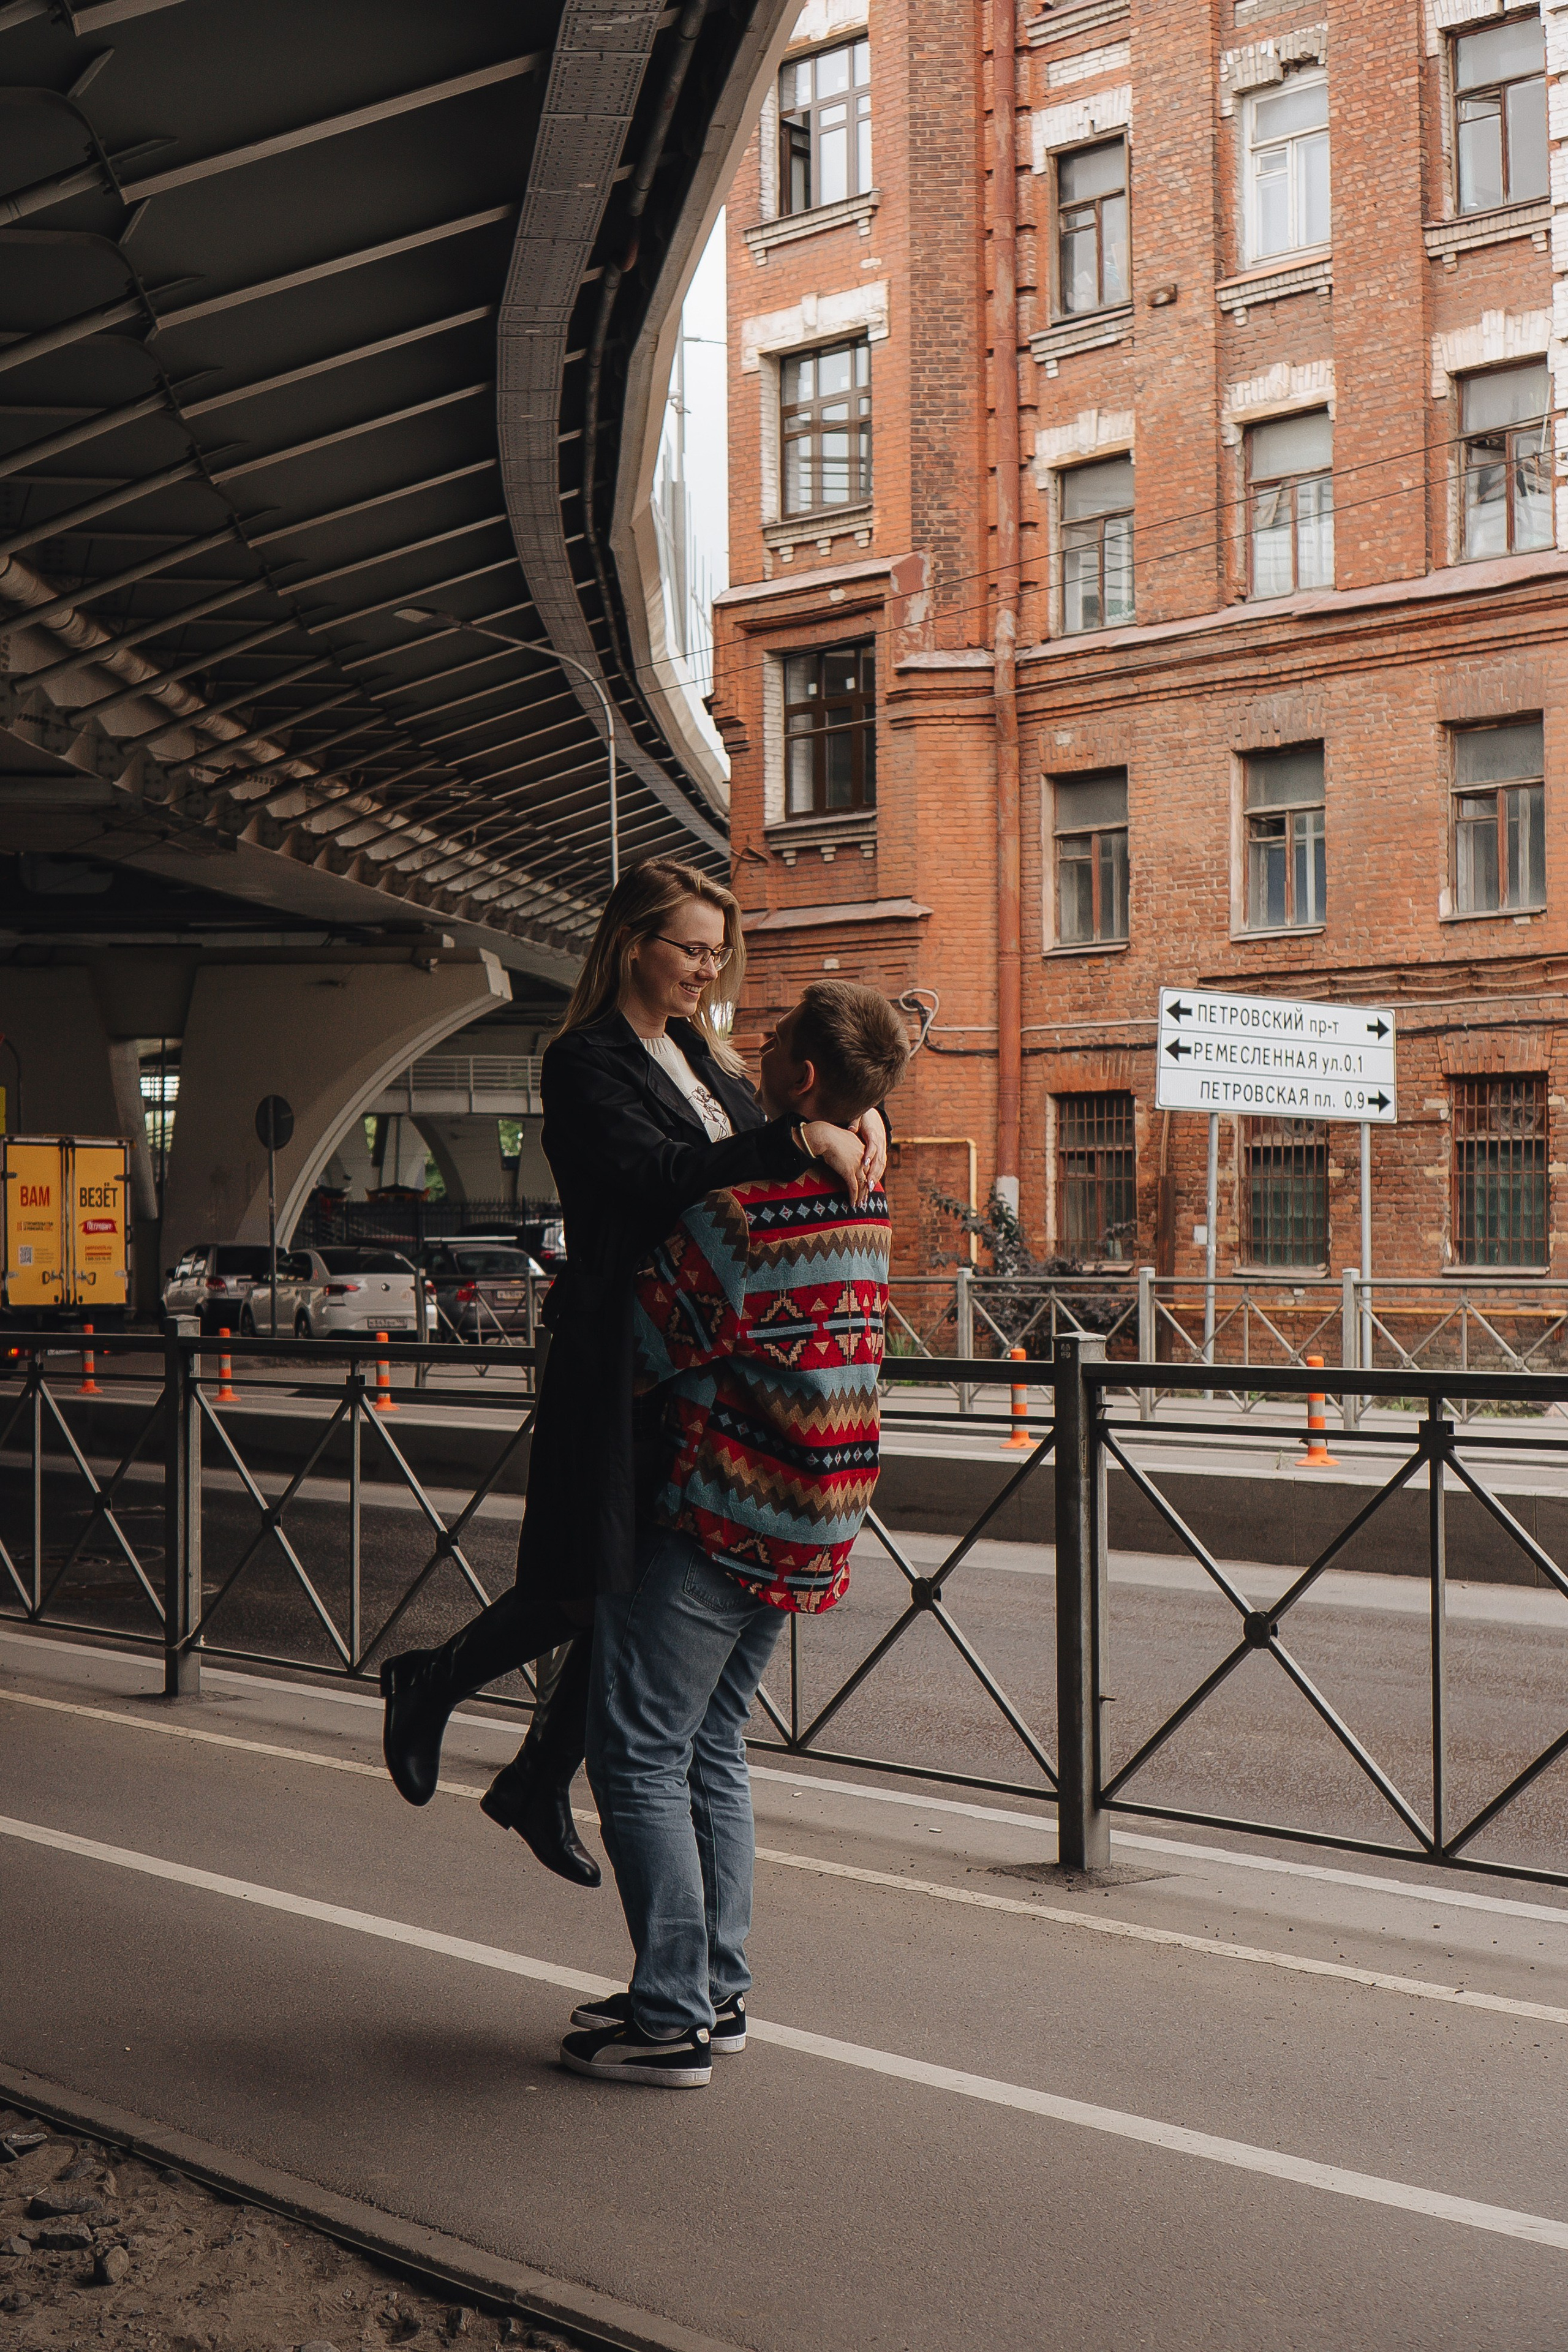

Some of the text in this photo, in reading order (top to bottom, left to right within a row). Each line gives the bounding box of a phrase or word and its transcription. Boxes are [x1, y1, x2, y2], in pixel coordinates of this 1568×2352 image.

[1198, 1004, 1339, 1037] ПЕТРОВСКИЙ пр-т
[1194, 1042, 1317, 1069] РЕМЕСЛЕННАЯ
[1200, 1081, 1365, 1110] ПЕТРОВСКАЯ пл. 0,9
[20, 1182, 118, 1207] ВАМ ВЕЗЁТ
